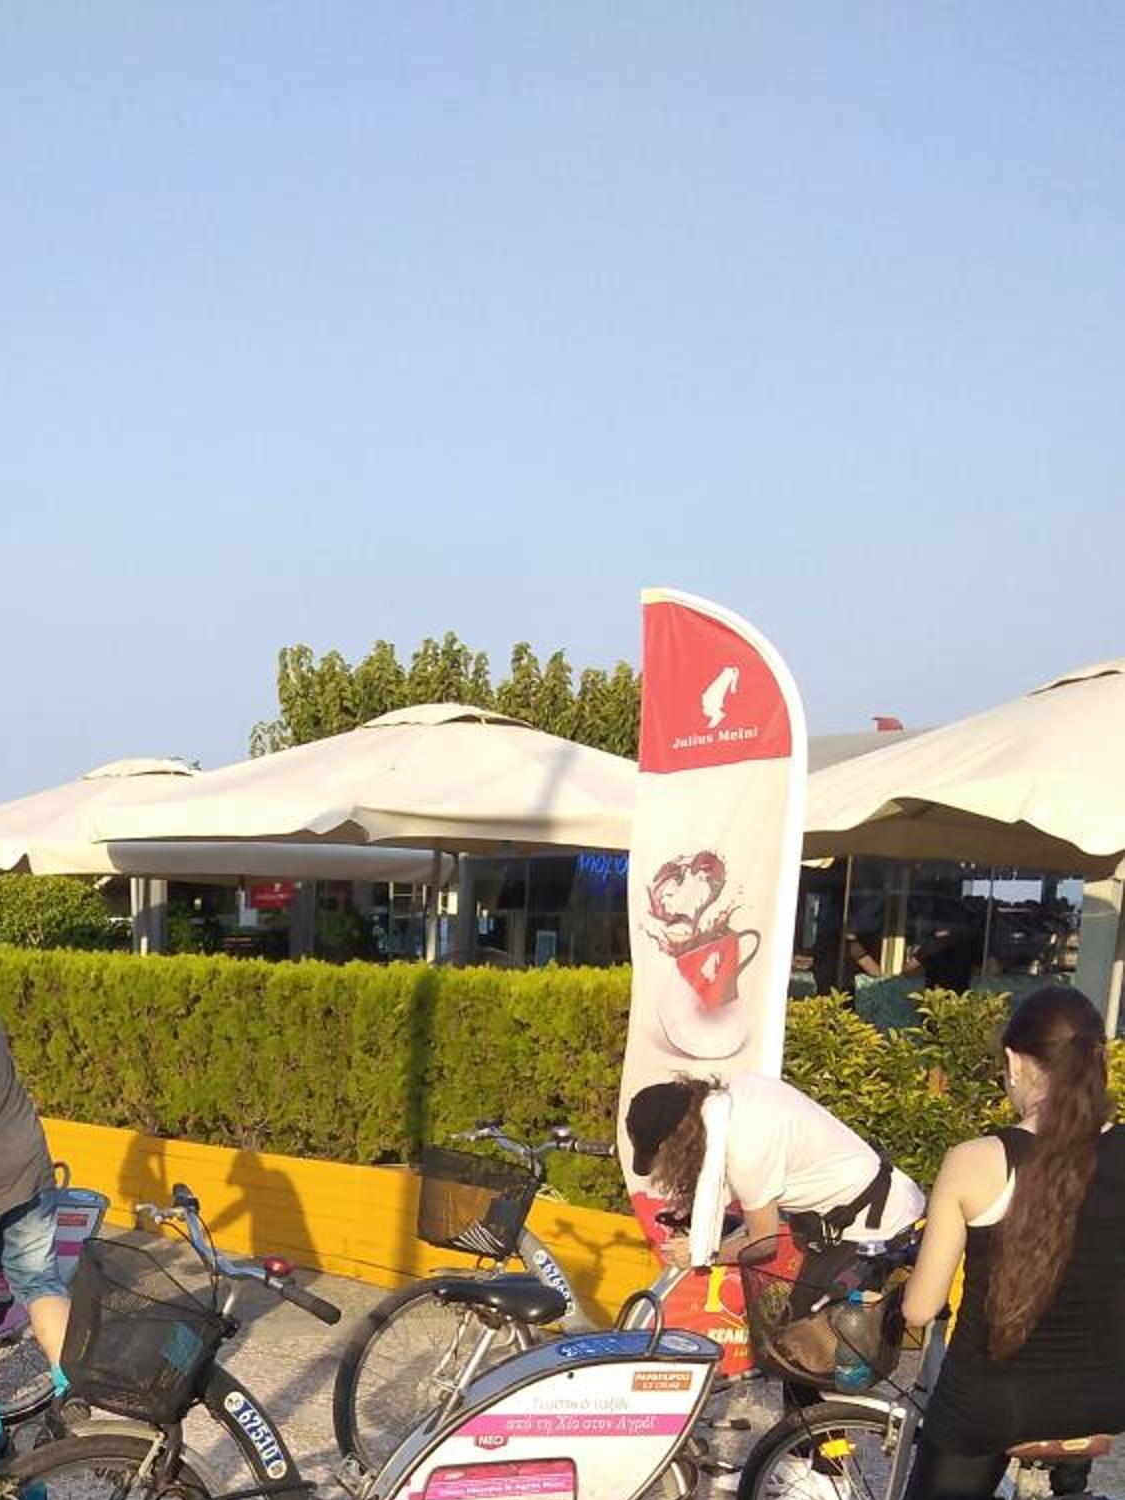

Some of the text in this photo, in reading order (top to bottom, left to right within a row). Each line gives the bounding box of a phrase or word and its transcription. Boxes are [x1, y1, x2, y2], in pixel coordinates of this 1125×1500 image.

[672, 725, 758, 750] Julius Meinl
[237, 1409, 277, 1460] 67510
